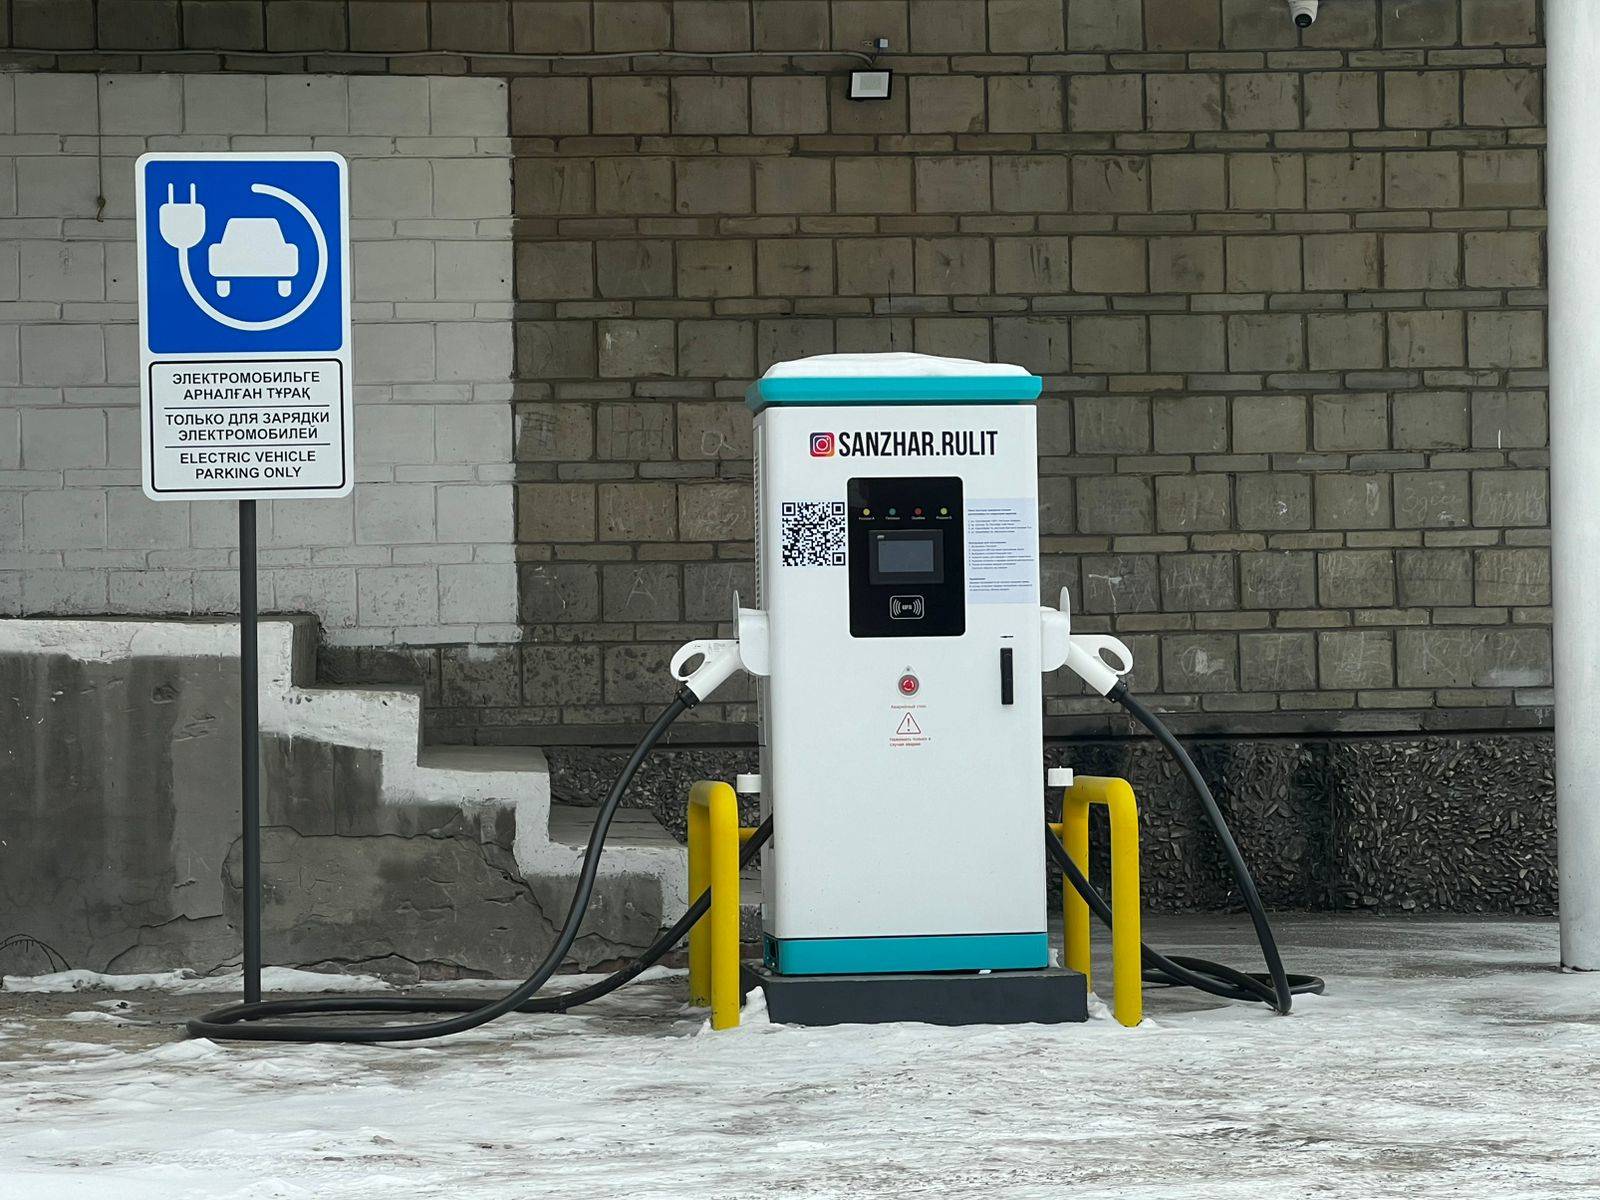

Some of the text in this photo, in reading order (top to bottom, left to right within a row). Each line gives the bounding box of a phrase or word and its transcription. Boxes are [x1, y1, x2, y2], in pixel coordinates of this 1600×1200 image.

[172, 371, 320, 385] ЭЛЕКТРОМОБИЛЬГЕ
[183, 387, 311, 401] АРНАЛҒАН ТҰРАҚ
[165, 411, 330, 426] ТОЛЬКО ДЛЯ ЗАРЯДКИ
[178, 426, 318, 441] ЭЛЕКТРОМОБИЛЕЙ
[838, 430, 998, 457] SANZHAR.RULIT
[180, 451, 316, 464] ELECTRIC VEHICLE
[195, 466, 302, 480] PARKING ONLY
